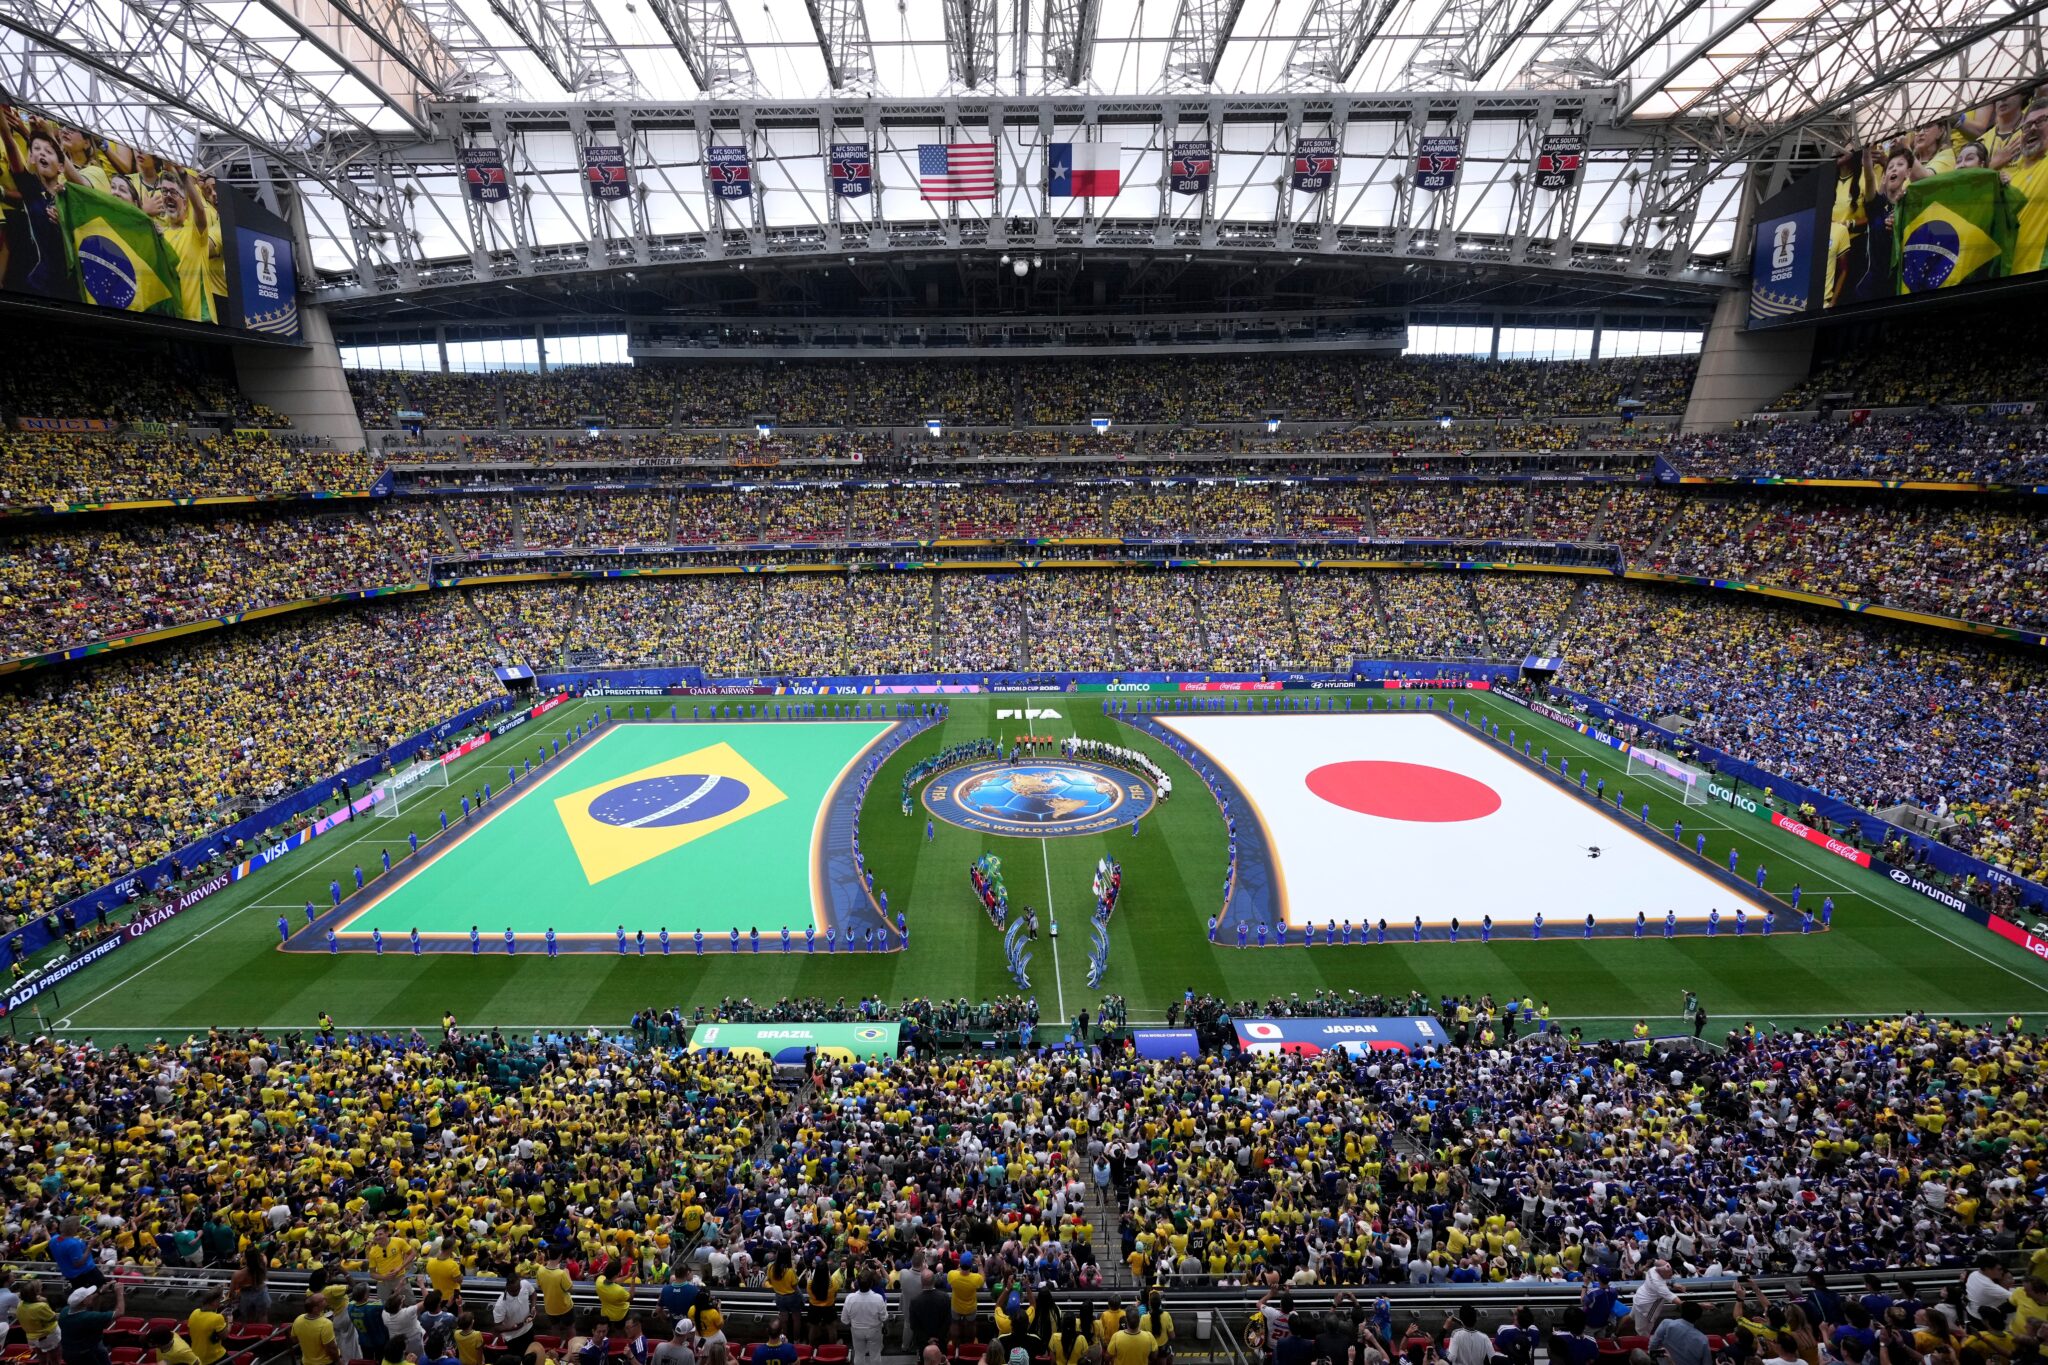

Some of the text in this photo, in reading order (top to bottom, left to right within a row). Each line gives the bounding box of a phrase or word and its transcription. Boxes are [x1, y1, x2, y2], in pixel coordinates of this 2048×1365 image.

[1299, 146, 1335, 154] CHAMPIONS
[1422, 144, 1458, 152] CHAMPIONS
[1543, 143, 1580, 151] CHAMPIONS
[709, 154, 746, 162] CHAMPIONS
[832, 151, 868, 159] CHAMPIONS
[465, 156, 500, 164] CHAMPIONS
[1179, 181, 1199, 190] 2018
[1301, 178, 1322, 187] 2019
[1424, 177, 1444, 186] 2023
[1542, 176, 1566, 186] 2024
[600, 187, 620, 196] 2012
[722, 186, 742, 195] 2015
[842, 183, 862, 192] 2016
[481, 188, 499, 198] 2011
[1771, 271, 1793, 282] 2026
[258, 289, 279, 299] 2026
[638, 458, 671, 466] CAMISA
[791, 686, 814, 694] VISA
[835, 686, 857, 694] VISA
[1106, 684, 1150, 692] aramco
[1185, 683, 1208, 691] Coca-Cola
[1219, 683, 1241, 691] Coca-Cola
[1254, 682, 1276, 690] Coca-Cola
[583, 689, 603, 697] ADI
[542, 699, 559, 712] Lenovo
[996, 708, 1062, 719] FIFA
[1530, 702, 1575, 728] QATAR AIRWAYS
[1604, 707, 1615, 716] FIFA
[505, 715, 526, 731] HYUNDAI
[1594, 729, 1612, 745] VISA
[932, 786, 949, 802] FIFA
[1128, 784, 1145, 800] FIFA
[1708, 783, 1756, 813] aramco
[964, 817, 1118, 833] FIFA WORLD CUP 2026
[1779, 817, 1808, 839] Coca-Cola
[262, 840, 290, 863] VISA
[1825, 838, 1859, 862] Coca-Cola
[1986, 868, 2013, 887] FIFA
[115, 877, 136, 894] FIFA
[1911, 880, 1966, 913] HYUNDAI
[129, 874, 229, 938] QATAR AIRWAYS
[7, 935, 122, 1011] ADI PREDICTSTREET
[1323, 1024, 1379, 1033] JAPAN
[757, 1030, 813, 1039] BRAZIL
[1704, 1165, 1712, 1173] 13
[1193, 1240, 1203, 1248] 00
